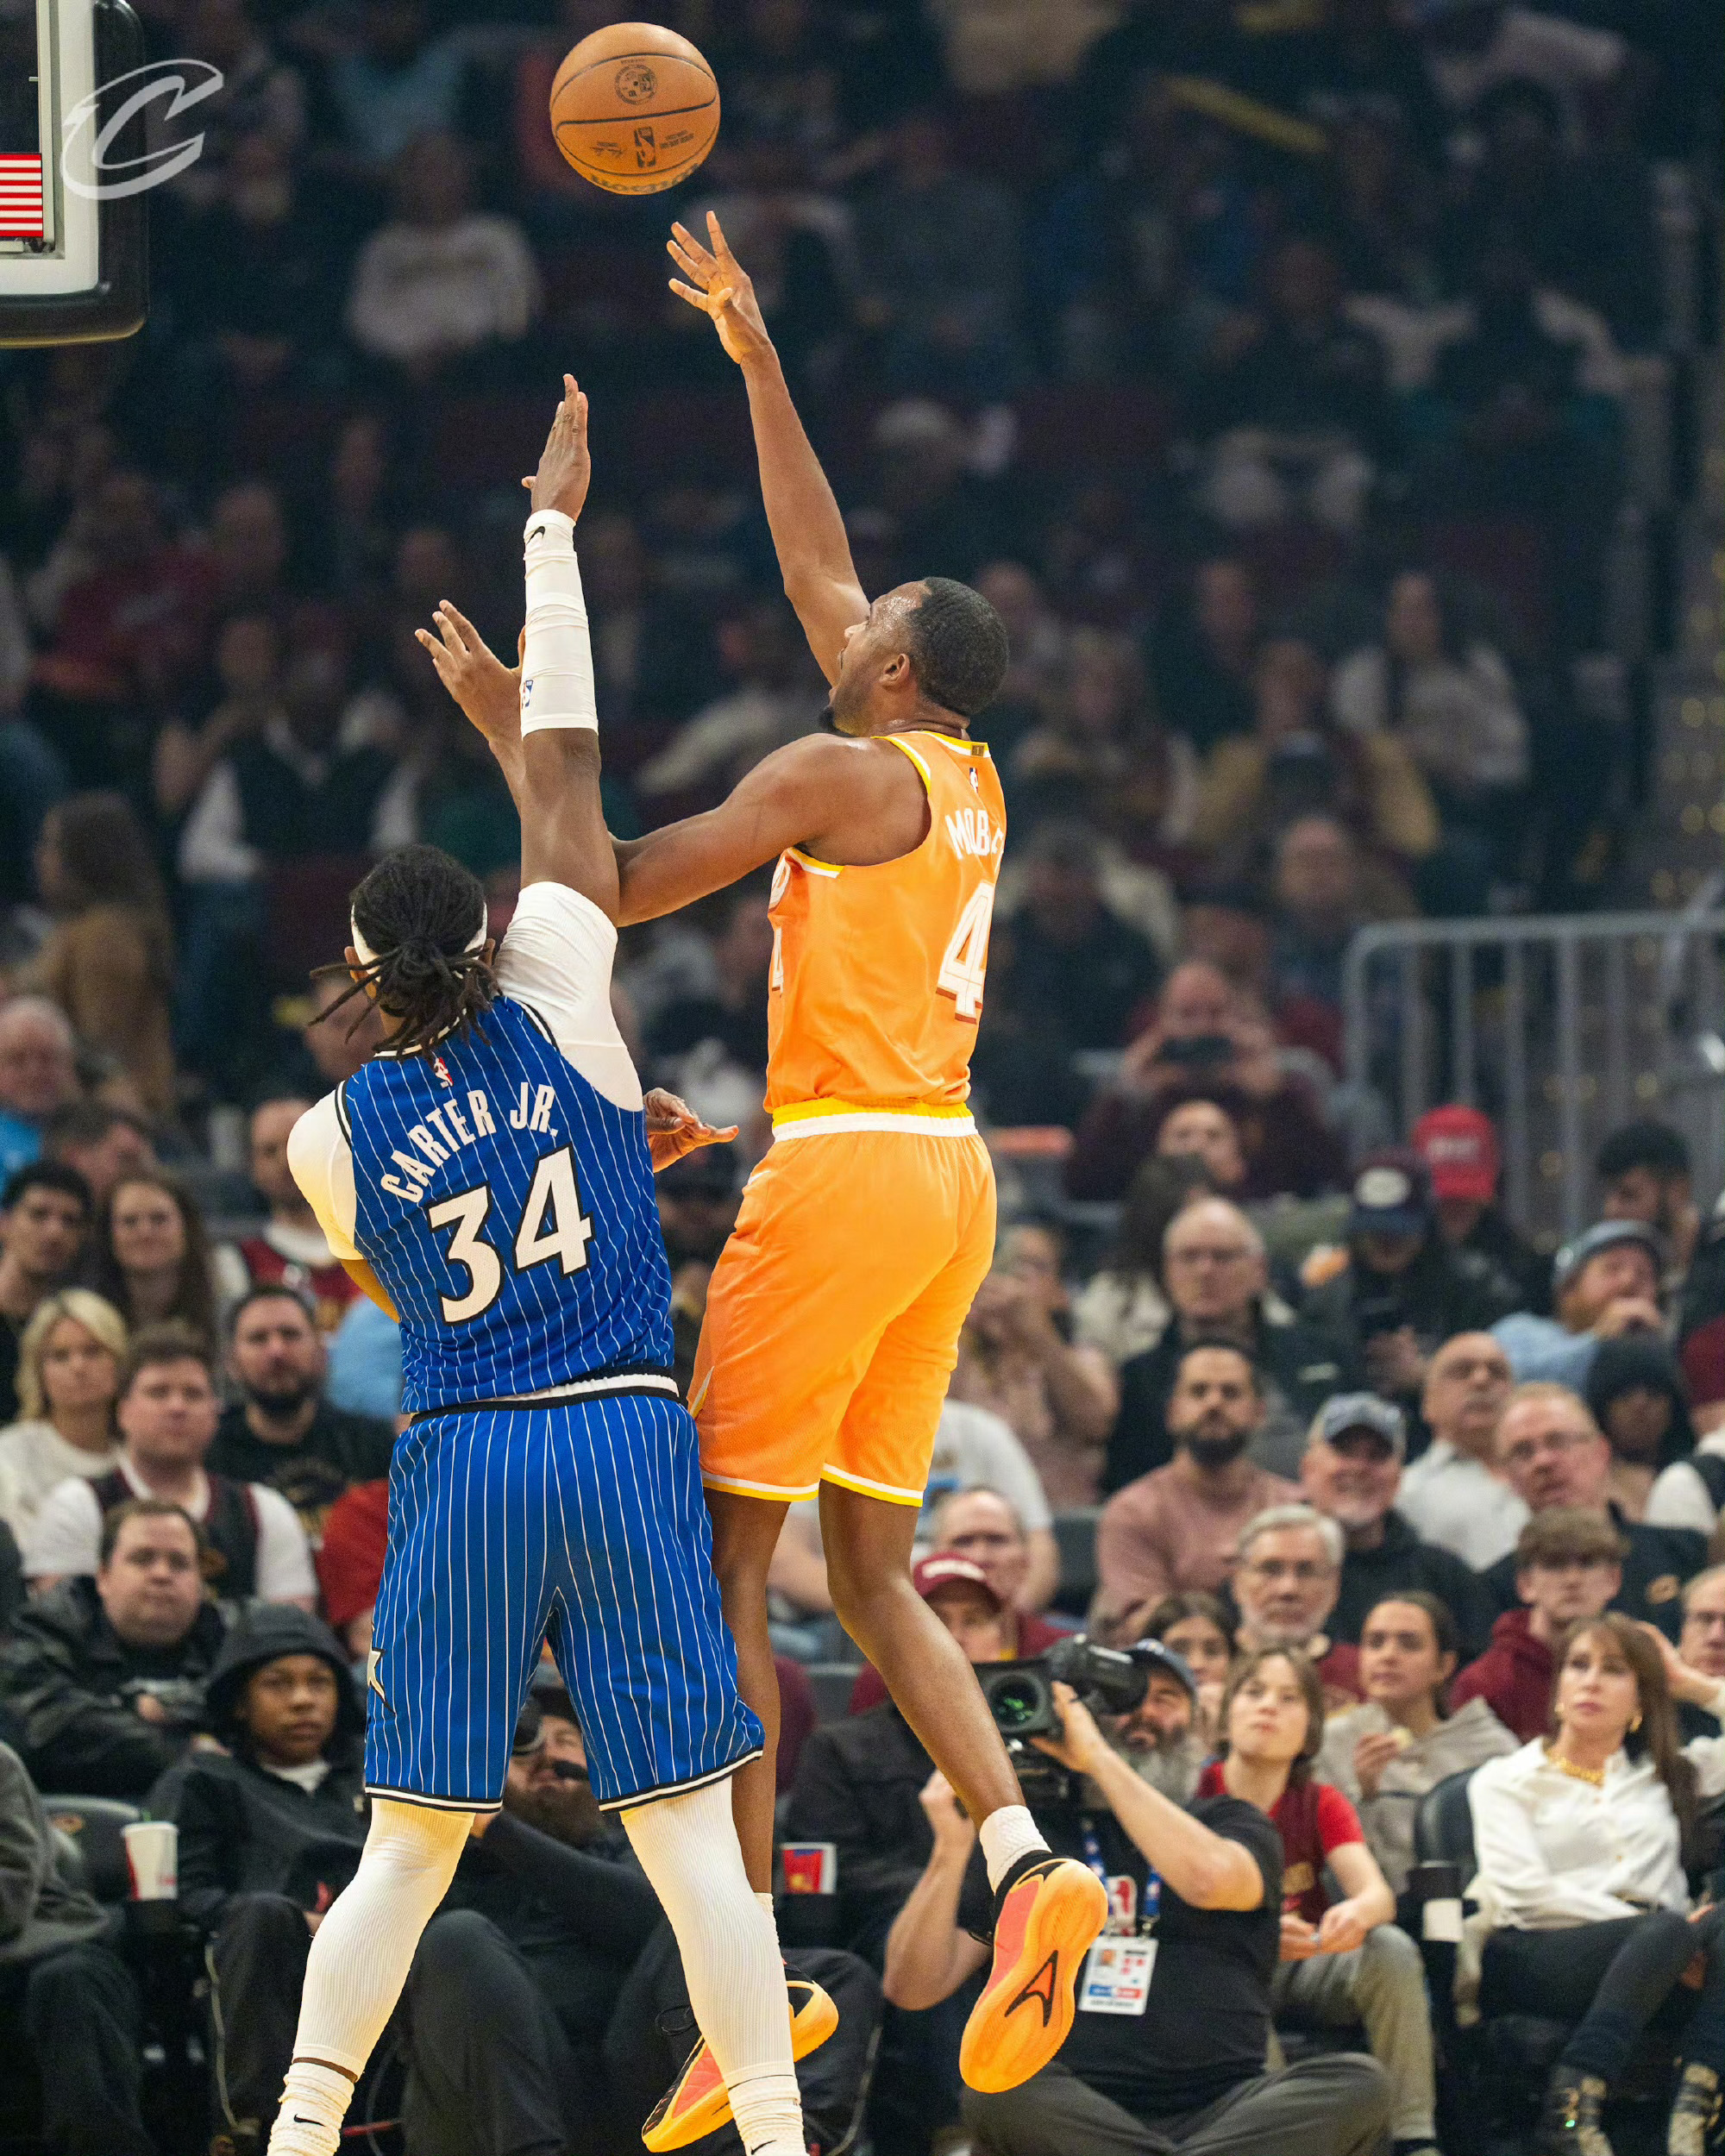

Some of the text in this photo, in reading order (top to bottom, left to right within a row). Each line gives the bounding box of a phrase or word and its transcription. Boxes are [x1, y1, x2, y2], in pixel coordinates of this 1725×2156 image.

[936, 881, 995, 1025] 4
[380, 1081, 559, 1203] CARTER JR.
[426, 1144, 594, 1325] 34
